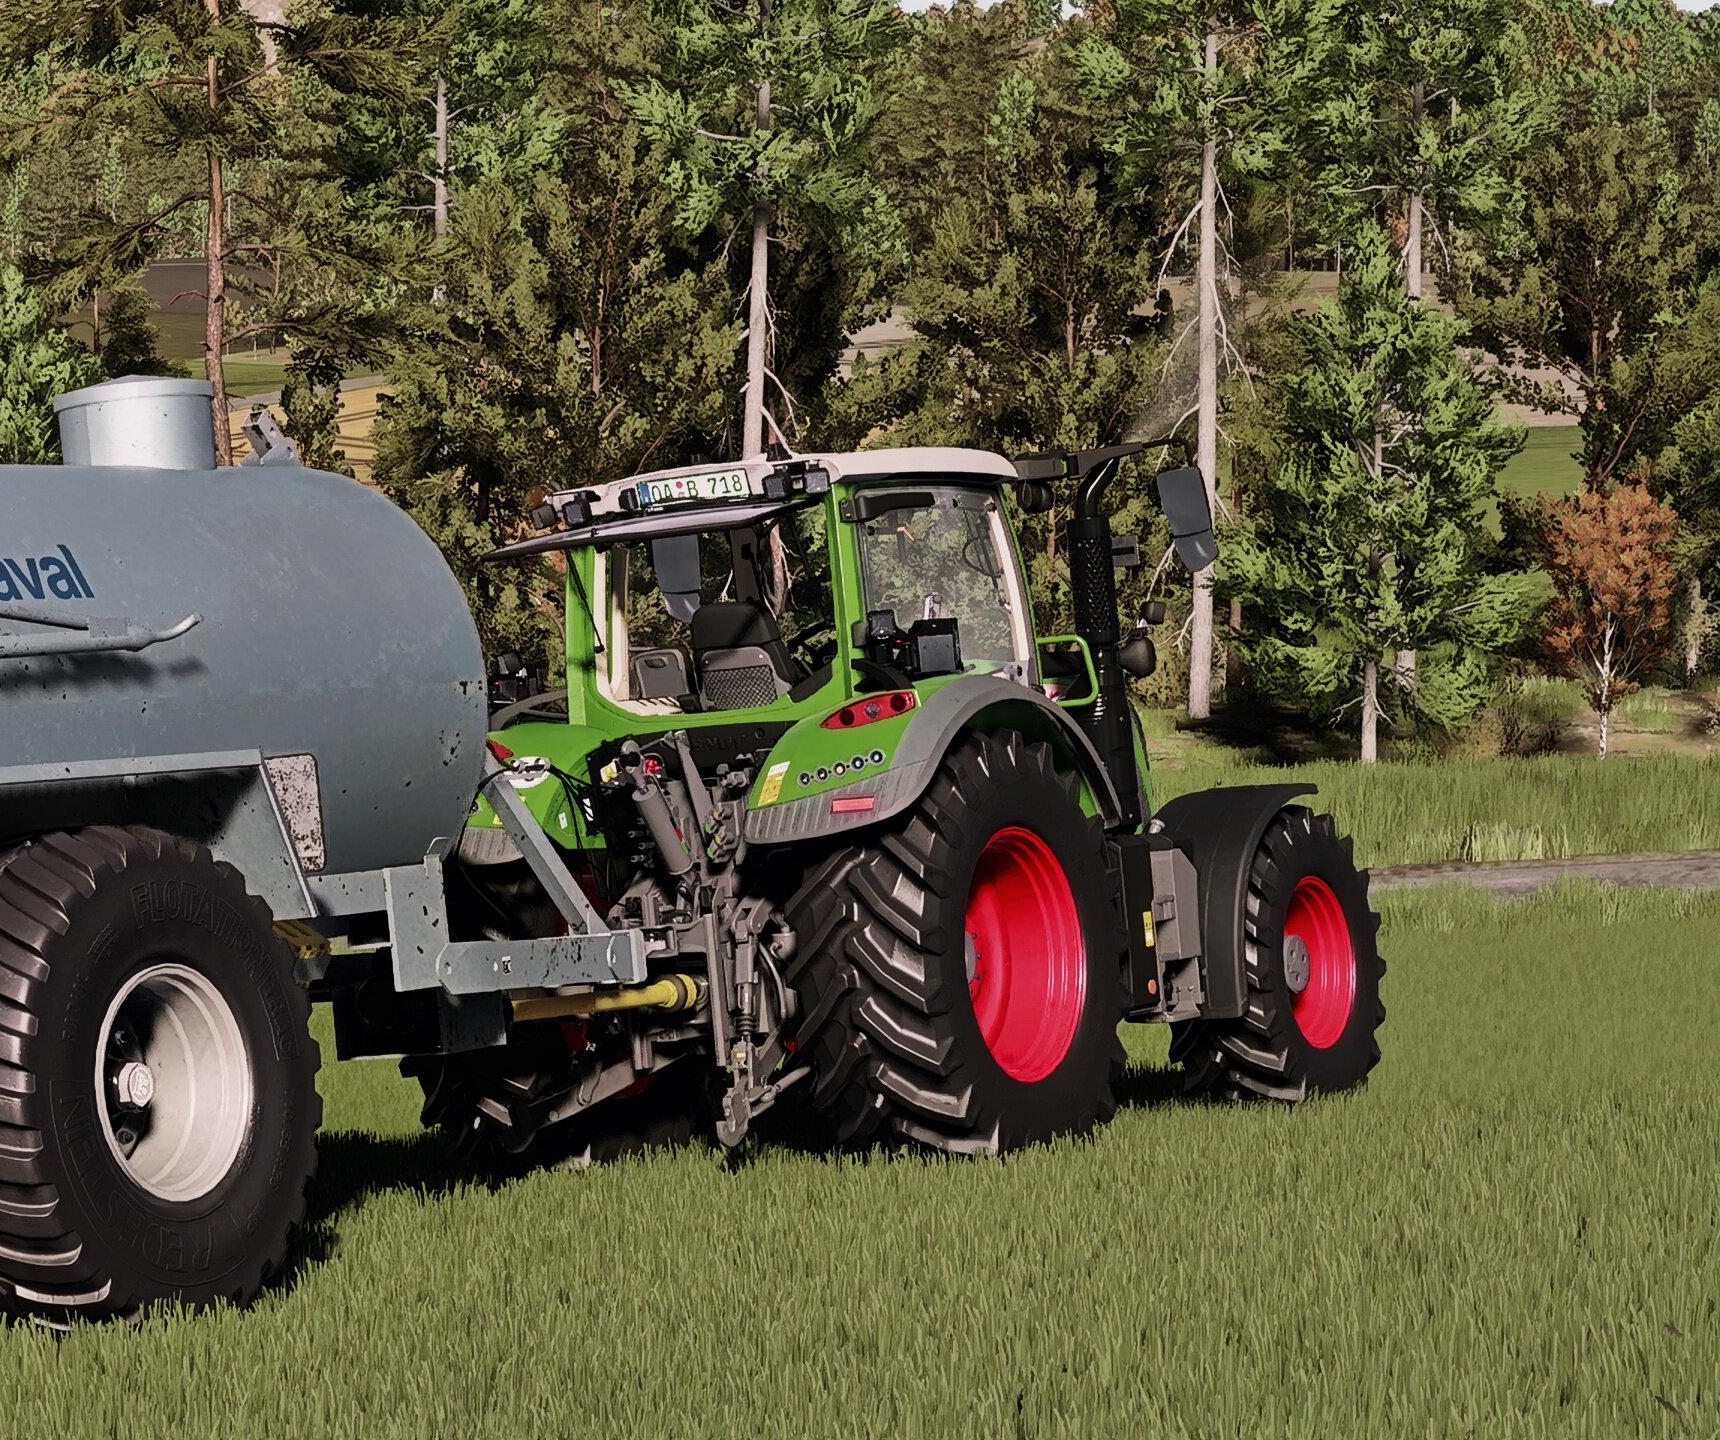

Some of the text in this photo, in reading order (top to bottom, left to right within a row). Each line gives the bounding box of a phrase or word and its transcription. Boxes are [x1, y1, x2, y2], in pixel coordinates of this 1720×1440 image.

[651, 474, 743, 502] OA B 718
[130, 877, 273, 985] FLOTATION
